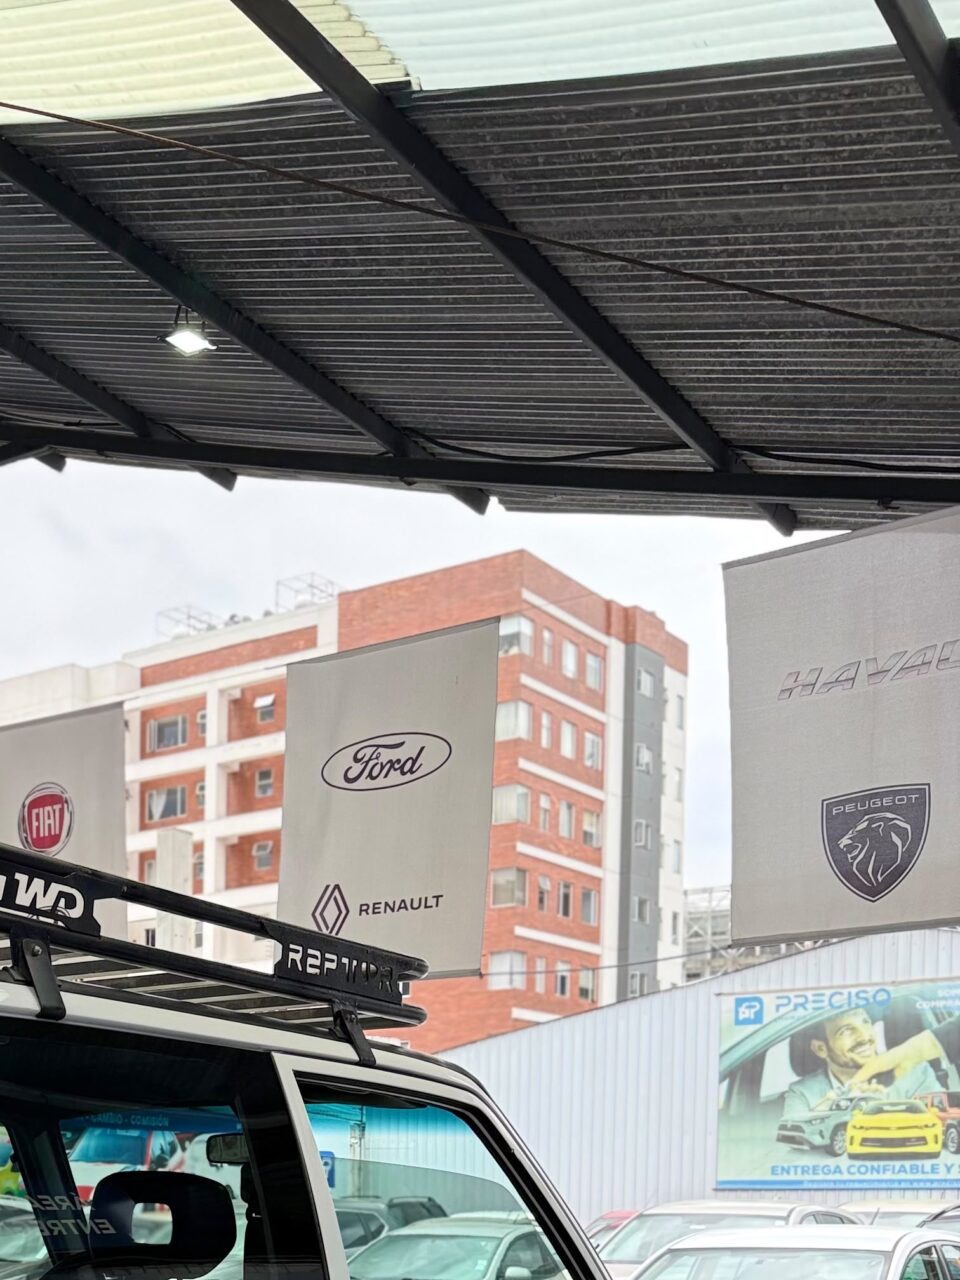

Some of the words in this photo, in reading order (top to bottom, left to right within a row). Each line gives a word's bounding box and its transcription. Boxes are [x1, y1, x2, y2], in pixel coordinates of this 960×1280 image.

[343, 740, 426, 784] Ford
[832, 794, 920, 816] PEUGEOT
[31, 803, 62, 839] FIAT
[358, 894, 444, 917] RENAULT
[775, 987, 892, 1012] PRECISO
[770, 1163, 844, 1177] ENTREGA
[846, 1162, 941, 1176] CONFIABLE
[943, 1162, 955, 1175] Y
